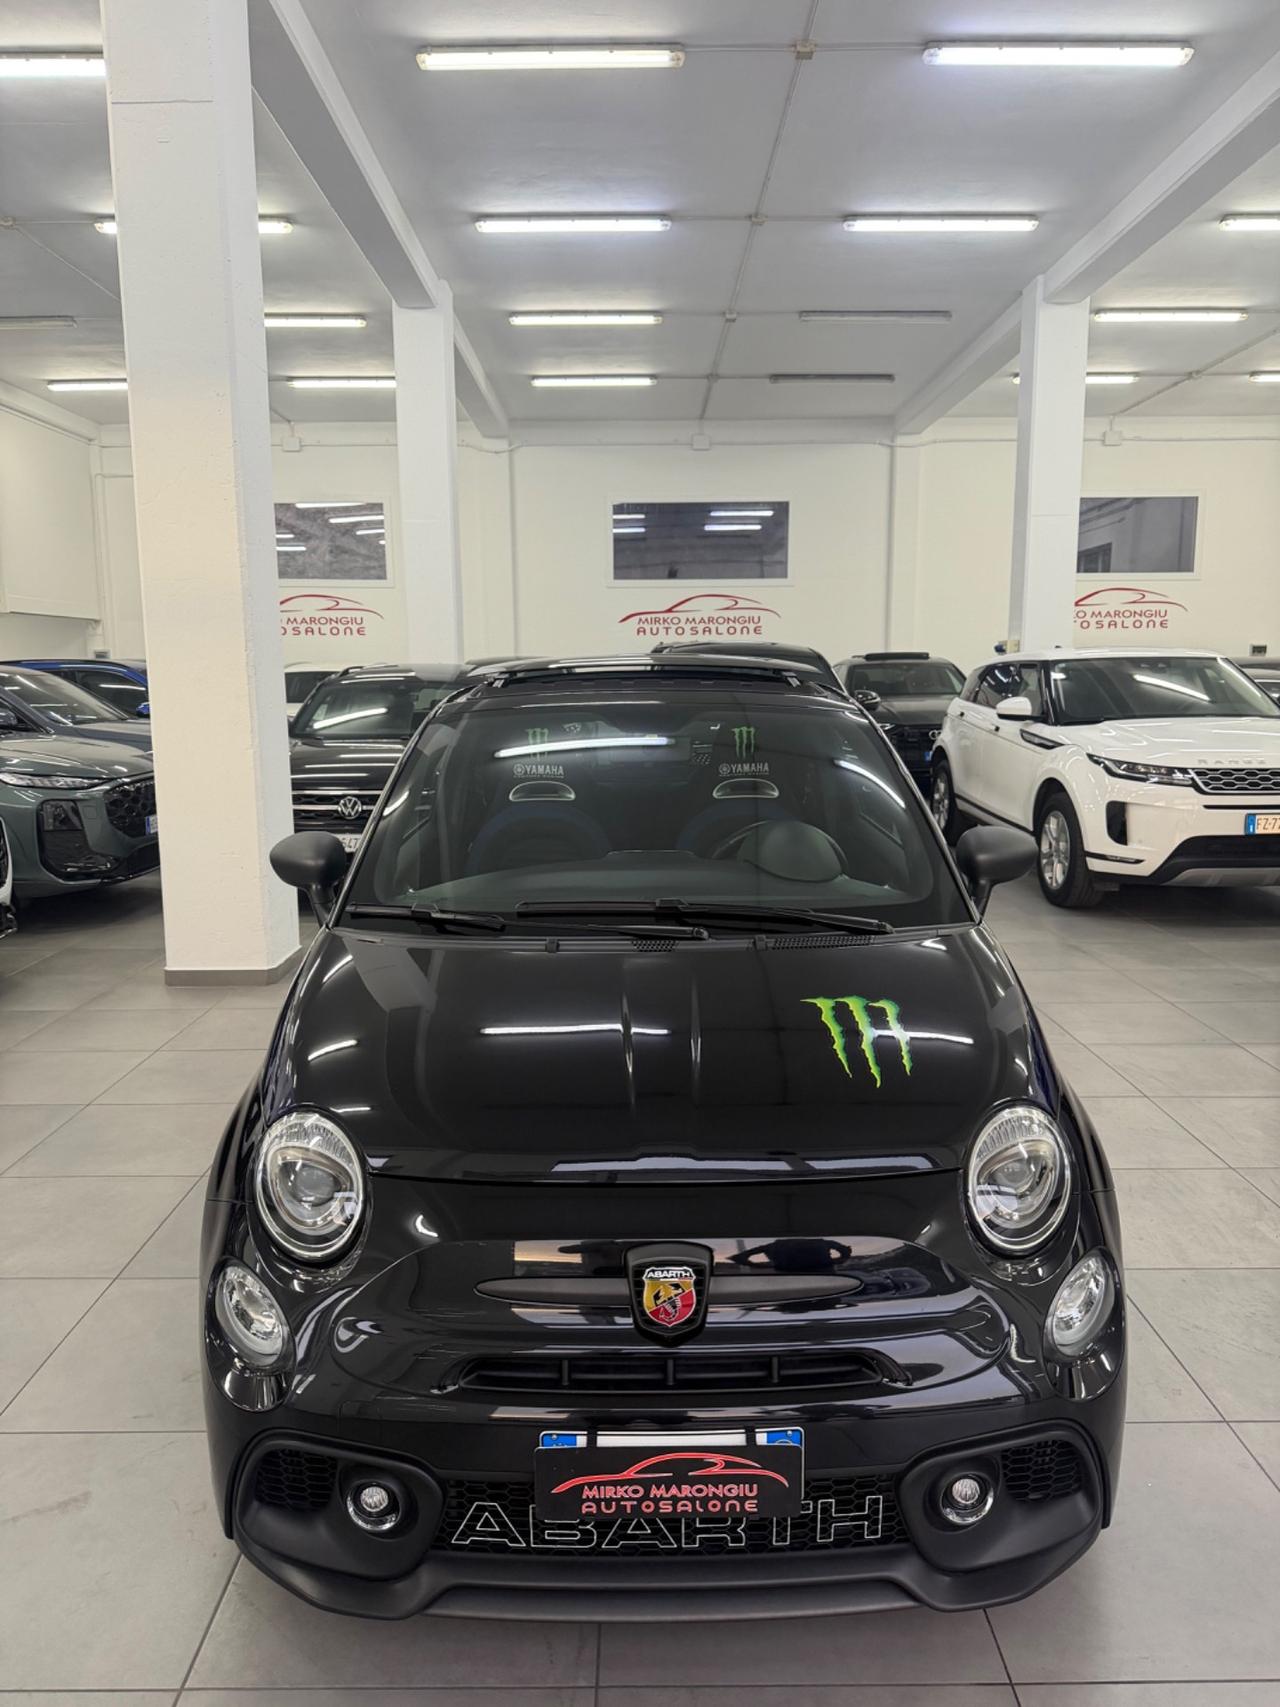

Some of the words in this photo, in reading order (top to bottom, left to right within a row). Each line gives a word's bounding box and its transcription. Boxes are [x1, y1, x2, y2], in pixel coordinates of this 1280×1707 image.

[1090, 609, 1168, 618] MARONGIU
[286, 616, 364, 625] MARONGIU
[637, 616, 681, 625] MIRKO
[684, 616, 761, 625] MARONGIU
[1073, 620, 1168, 629] OSALONE
[636, 626, 763, 636] AUTOSALONE
[525, 764, 564, 775] YAMAHA
[731, 762, 769, 773] YAMAHA
[647, 1270, 690, 1278] ABARTH
[582, 1484, 645, 1499] MIRKO
[650, 1484, 758, 1498] MARONGIU
[581, 1500, 758, 1514] AUTOSALONE
